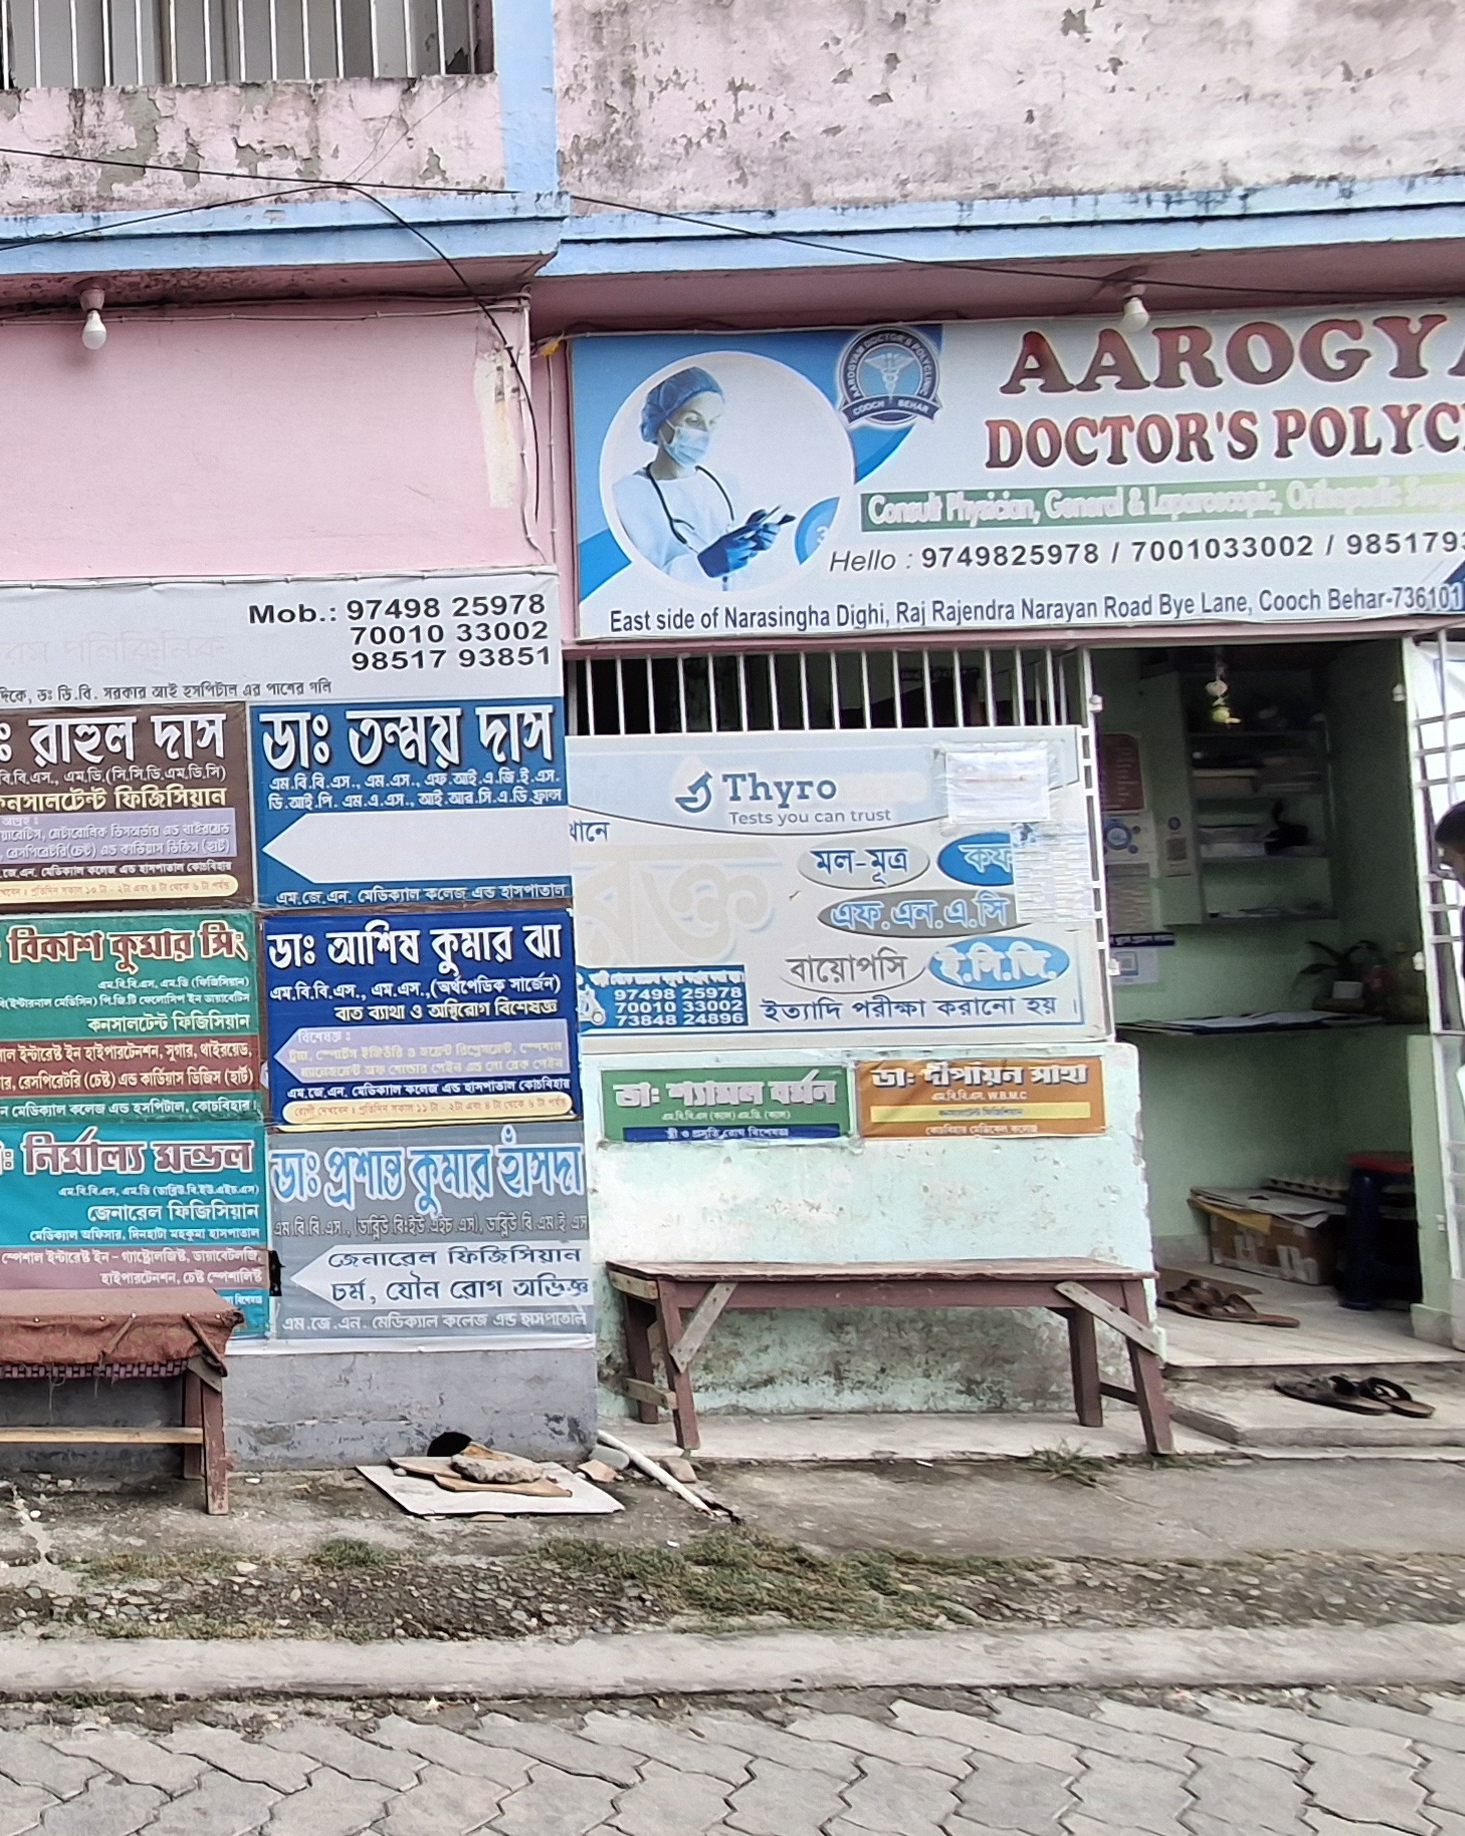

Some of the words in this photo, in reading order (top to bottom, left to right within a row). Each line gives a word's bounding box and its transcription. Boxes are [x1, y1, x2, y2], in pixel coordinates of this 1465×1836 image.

[999, 314, 1465, 395] AAROGY
[853, 401, 885, 415] COOCH
[898, 399, 929, 413] BEHAR
[985, 410, 1258, 469] DOCTOR'S
[1273, 402, 1465, 459] POLYC
[829, 548, 896, 572] Hello
[921, 541, 1100, 569] 9749825978
[1132, 534, 1313, 562] 7001033002
[248, 604, 337, 625] Mob.:
[347, 600, 441, 620] 97498
[452, 594, 545, 616] 25978
[611, 610, 650, 632] East
[656, 606, 695, 630] side
[724, 605, 830, 631] Narasingha
[836, 604, 890, 630] Dighi,
[896, 601, 926, 626] Raj
[933, 598, 1015, 625] Rajendra
[1021, 594, 1097, 623] Narayan
[1104, 595, 1153, 618] Road
[1159, 592, 1195, 618] Bye
[1201, 589, 1253, 615] Lane,
[1259, 589, 1321, 611] Cooch
[1328, 583, 1462, 611] Behar-736101
[351, 624, 445, 647] 70010
[456, 621, 549, 643] 33002
[352, 650, 446, 671] 98517
[459, 646, 551, 668] 93851
[28, 716, 136, 767] রাহুল
[151, 713, 227, 760] দাস
[259, 713, 330, 771] ডাঃ
[346, 708, 462, 769] তন্ময়
[475, 705, 553, 763] দাস
[722, 773, 836, 808] Thyro
[730, 811, 772, 825] Tests
[778, 811, 811, 825] you
[817, 810, 847, 822] can
[852, 808, 892, 822] trust
[7, 925, 104, 964] বিকাশ
[107, 930, 194, 975] কুমার
[267, 934, 315, 969] ডাঃ
[326, 920, 420, 966] আশিষ
[430, 926, 513, 977] কুমার
[524, 924, 561, 959] ঝা
[614, 989, 675, 1000] 97498
[682, 987, 742, 999] 25978
[616, 1002, 676, 1013] 70010
[683, 1000, 743, 1012] 33002
[852, 995, 926, 1019] পরীক্ষা
[937, 997, 1015, 1017] করানো
[616, 1015, 677, 1026] 73848
[683, 1013, 744, 1024] 24896
[269, 1150, 321, 1202] ডাঃ
[407, 1146, 492, 1219] কুমার
[496, 1124, 583, 1197] হাঁসদা
[328, 1251, 435, 1268] জেনারেল
[386, 1271, 440, 1301] যৌন
[450, 1279, 503, 1299] রোগ
